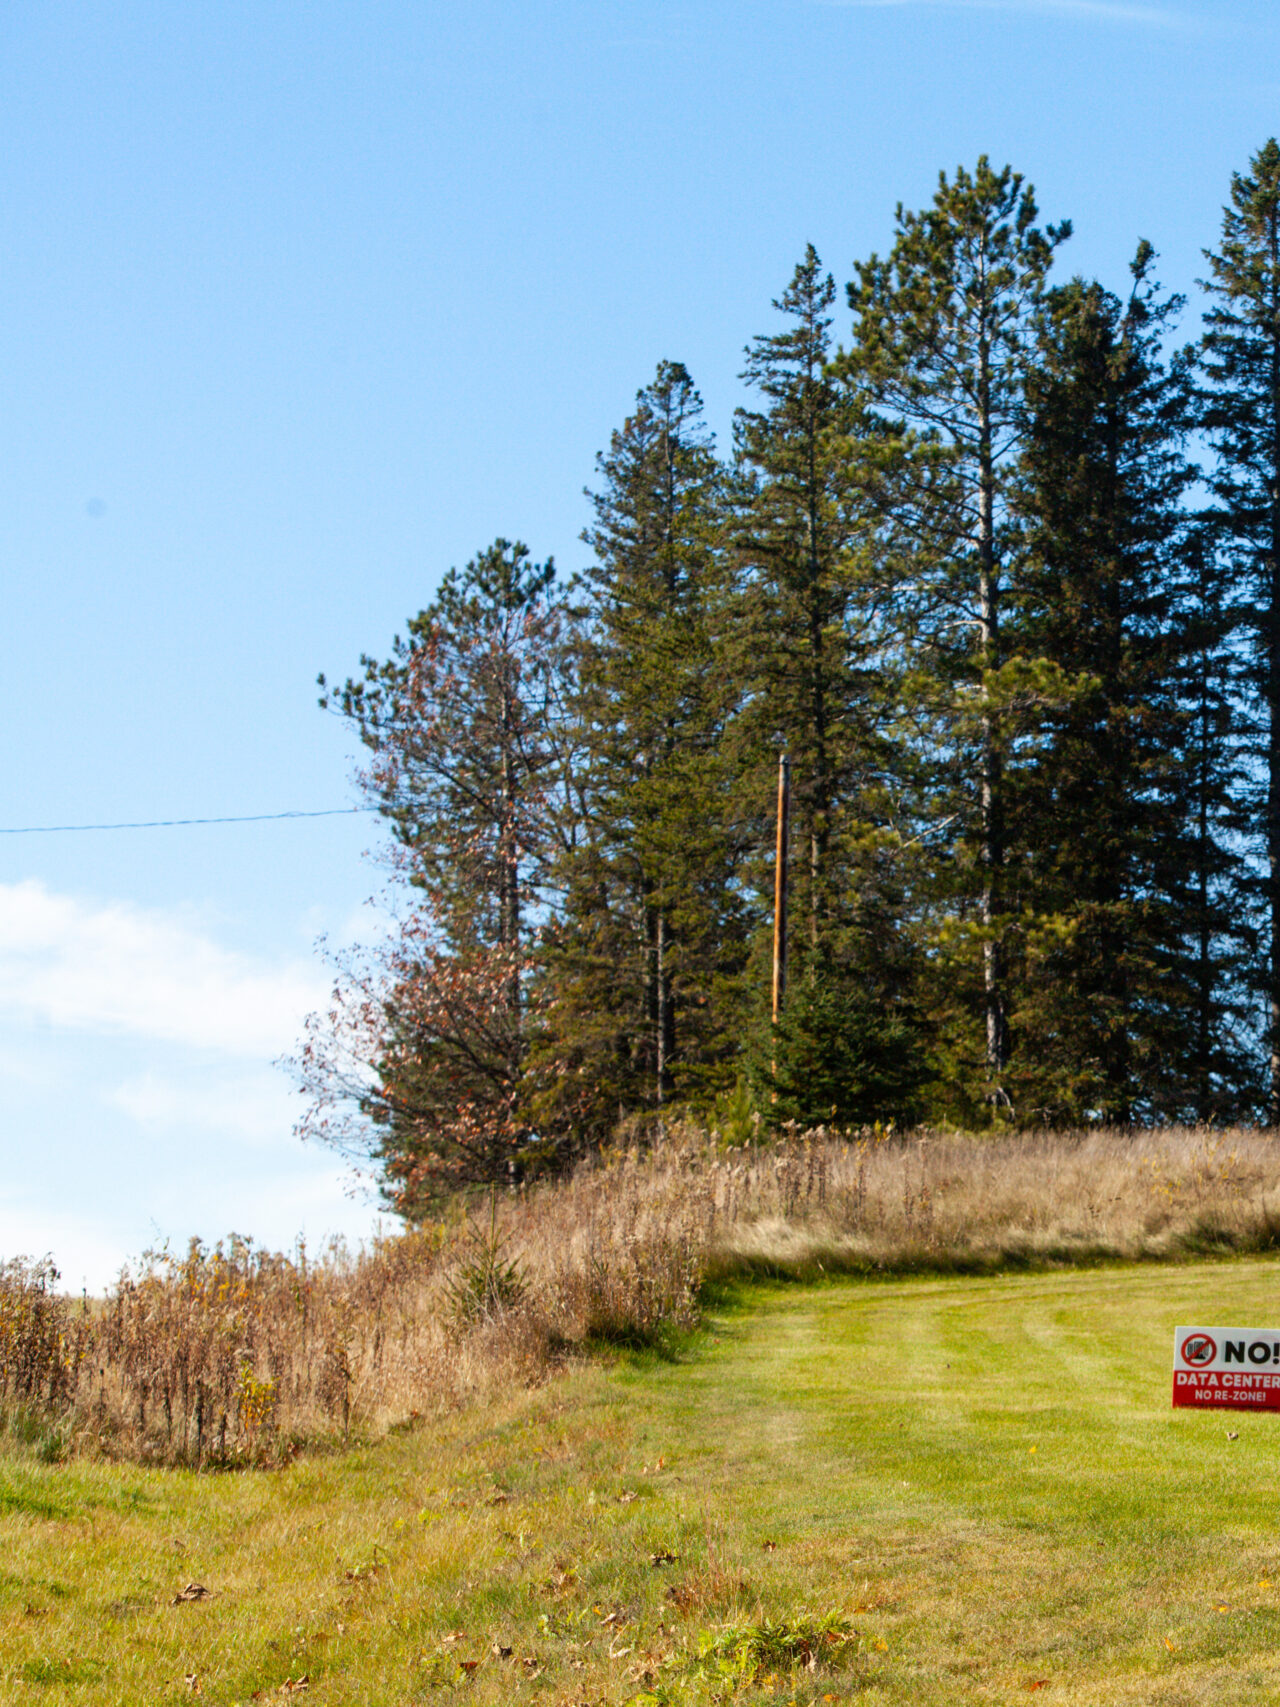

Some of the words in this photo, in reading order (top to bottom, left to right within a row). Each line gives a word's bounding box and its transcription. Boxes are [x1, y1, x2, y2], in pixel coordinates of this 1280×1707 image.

[1224, 1340, 1280, 1365] NO!
[1176, 1372, 1219, 1387] DATA
[1195, 1389, 1212, 1400] NO
[1214, 1390, 1267, 1402] RE-ZONE!
